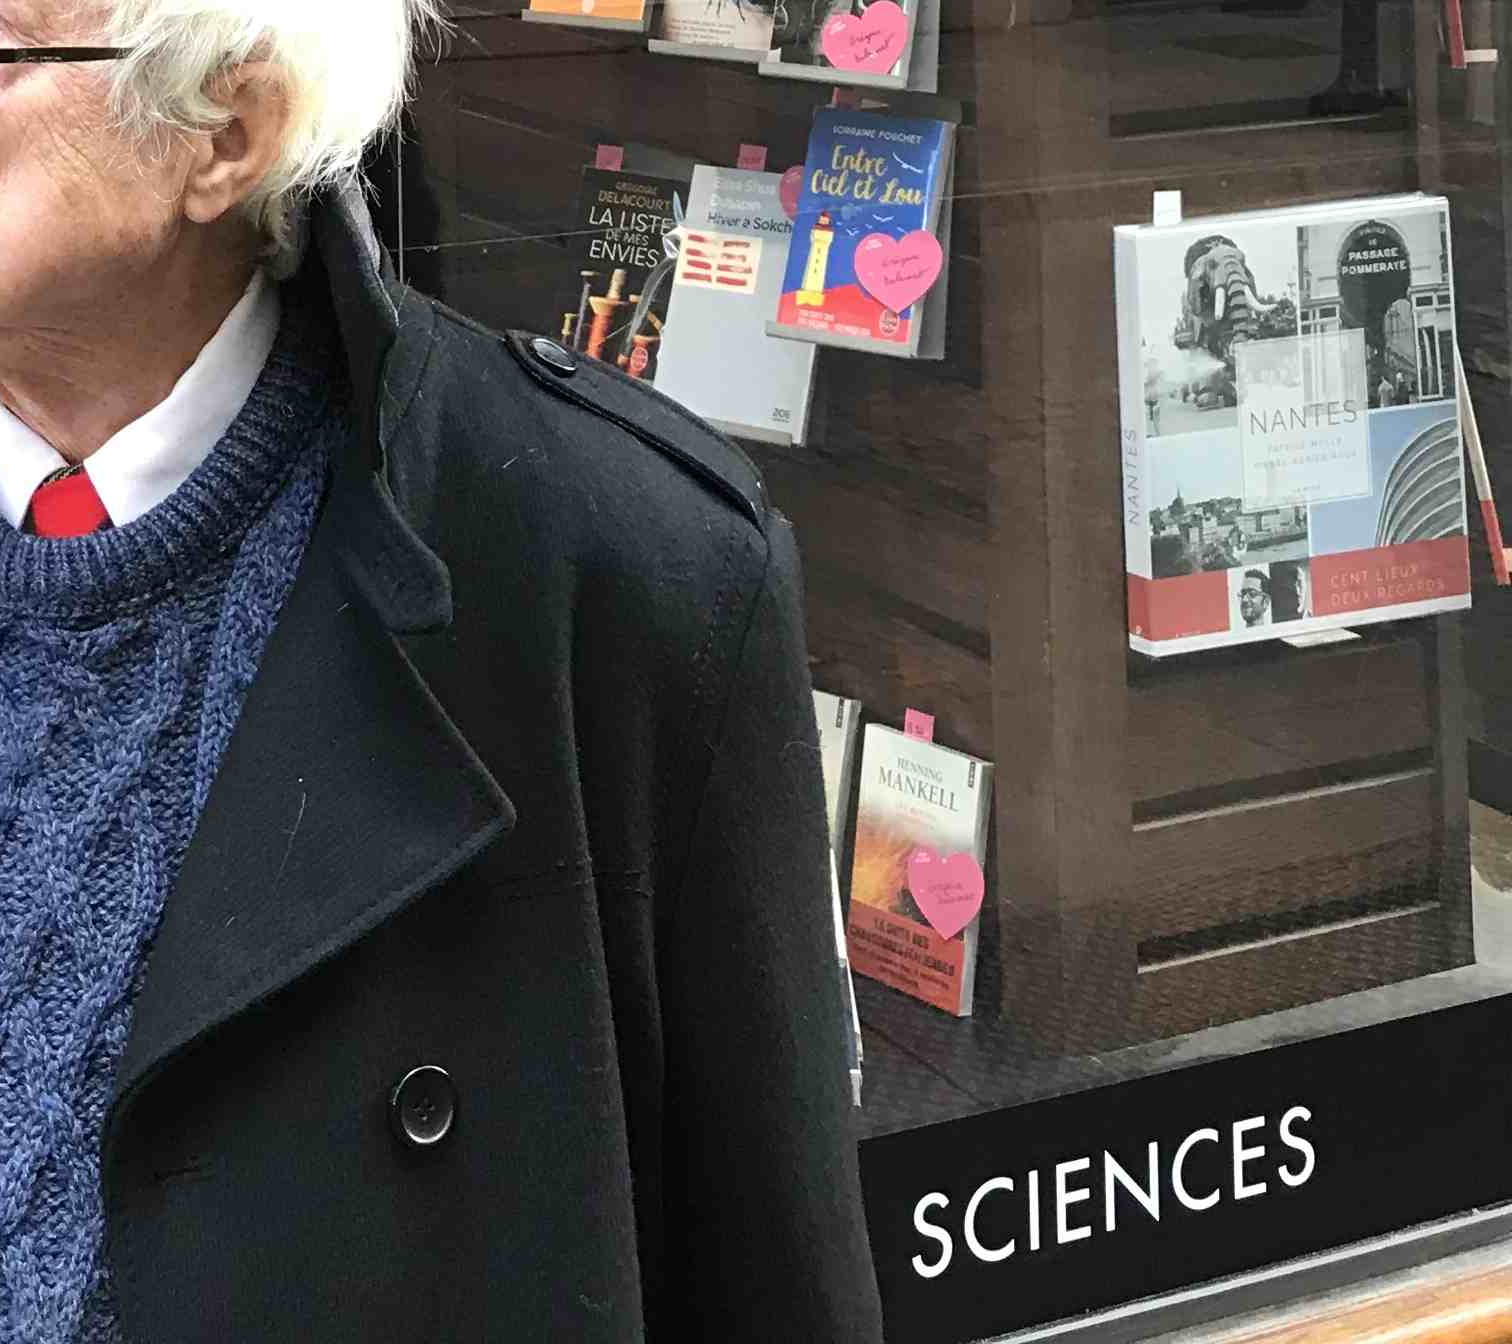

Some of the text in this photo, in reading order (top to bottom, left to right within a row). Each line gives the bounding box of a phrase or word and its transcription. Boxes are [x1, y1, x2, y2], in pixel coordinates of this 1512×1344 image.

[832, 144, 888, 176] Entre
[598, 190, 671, 210] DELACOURT
[812, 169, 922, 205] Ciel et Lou
[589, 206, 673, 236] LA LISTE
[708, 211, 792, 234] Hiver à Sokch
[606, 228, 649, 246] DE MES
[589, 240, 660, 268] ENVIES
[1250, 399, 1357, 435] NANTES
[1125, 429, 1139, 526] NANTES
[1329, 570, 1368, 589] CENT
[1331, 590, 1369, 608] DEUX
[896, 757, 943, 783] HENNING
[878, 765, 959, 813] MANKELL
[911, 1106, 1316, 1278] SCIENCES
